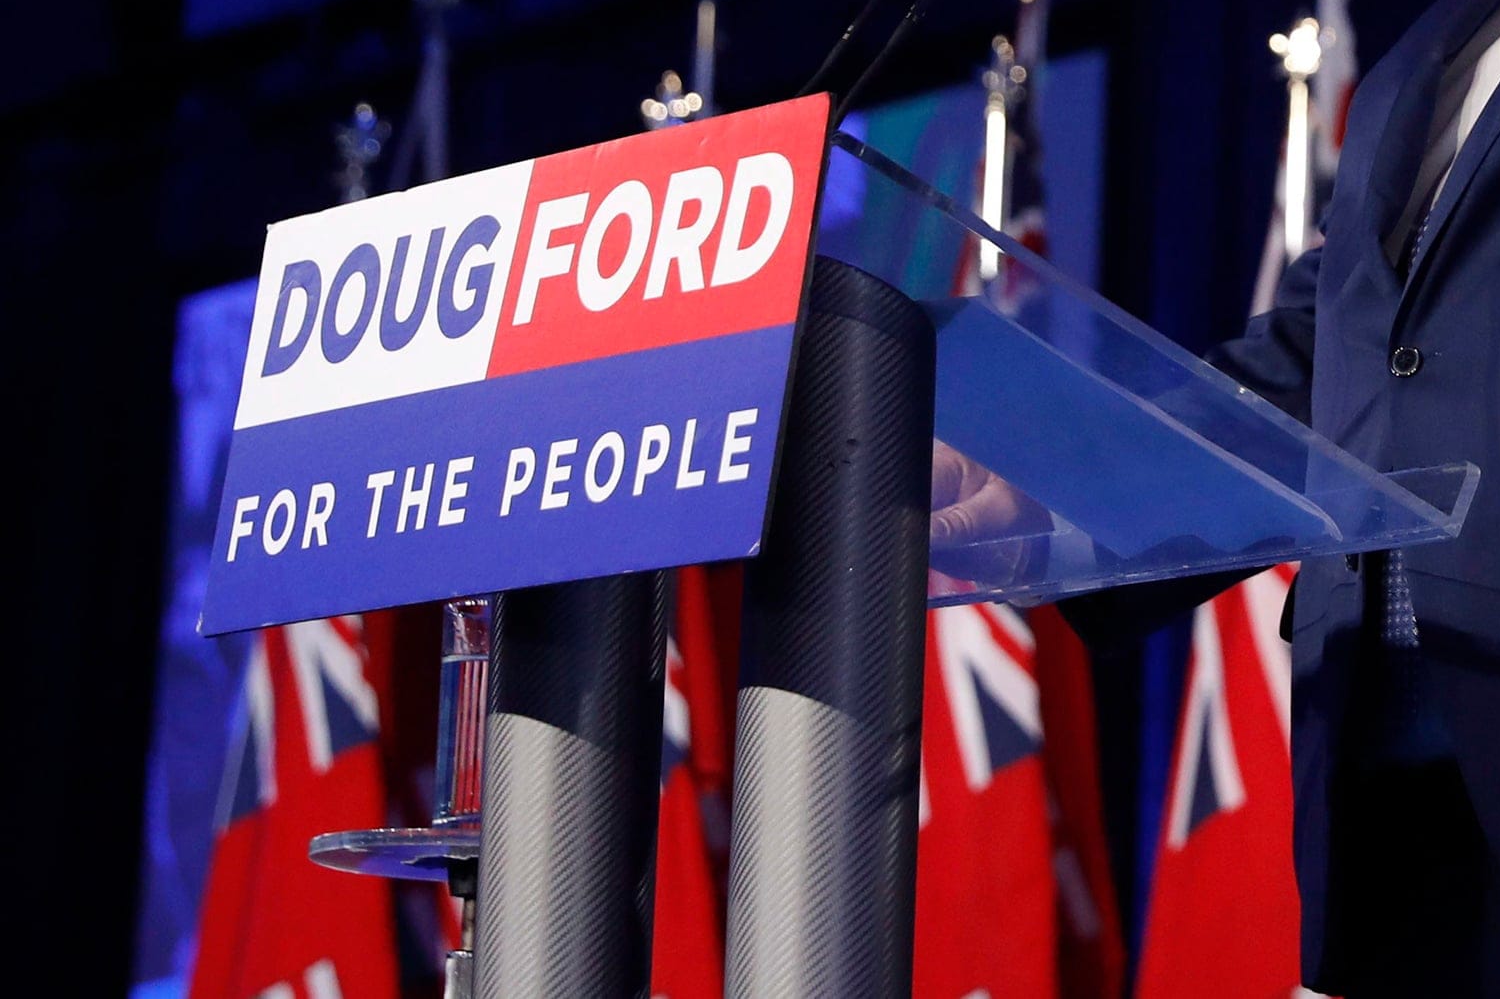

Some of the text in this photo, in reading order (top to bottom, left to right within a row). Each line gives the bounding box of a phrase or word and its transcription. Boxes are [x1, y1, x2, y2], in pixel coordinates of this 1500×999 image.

[261, 152, 794, 377] DOUG FORD
[226, 408, 759, 562] FOR THE PEOPLE
